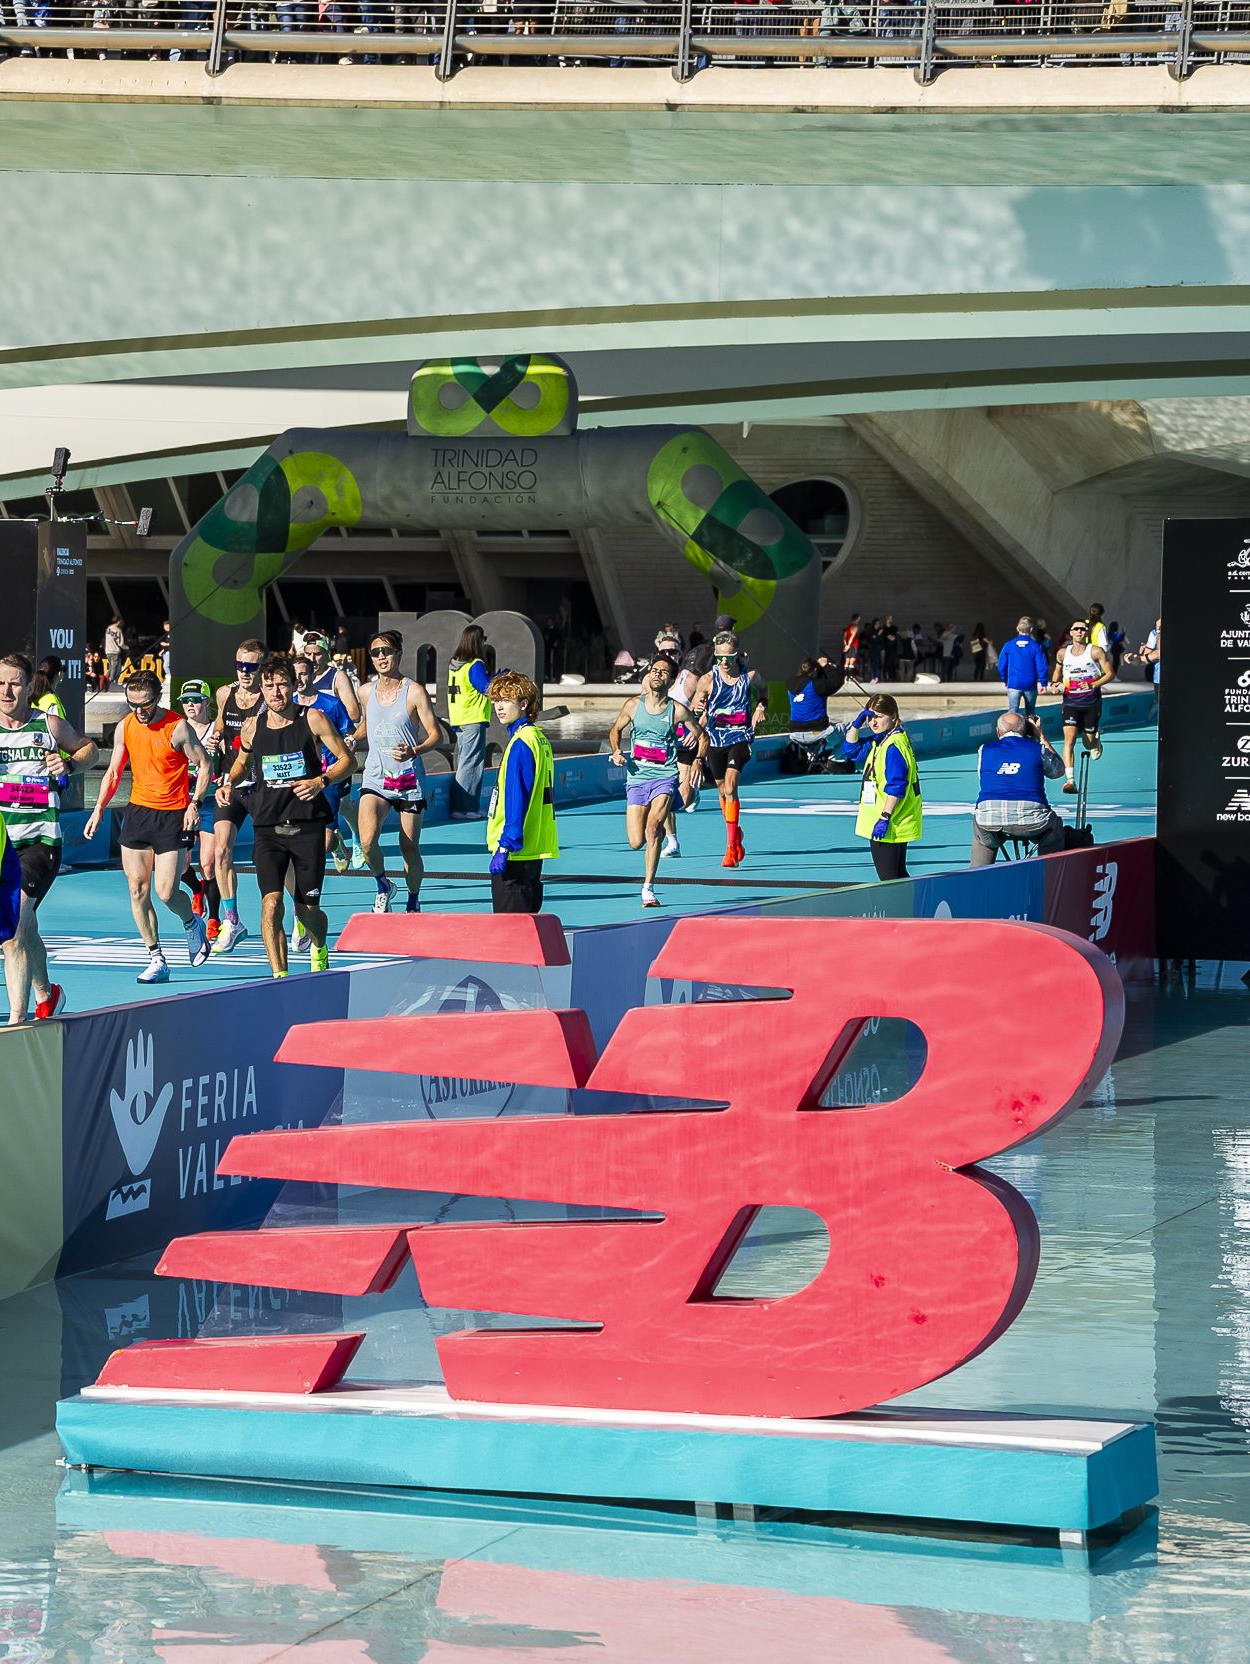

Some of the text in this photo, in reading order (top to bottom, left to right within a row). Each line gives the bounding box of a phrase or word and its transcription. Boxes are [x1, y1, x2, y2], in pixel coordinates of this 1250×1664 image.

[430, 448, 538, 468] TRINIDAD
[430, 470, 537, 491] ALFONSO
[431, 493, 536, 504] FUNDACIÓN
[50, 629, 74, 649] YOU
[1220, 639, 1234, 647] DE
[68, 659, 82, 679] IT!
[1216, 813, 1236, 821] new
[180, 1065, 258, 1132] FERIA
